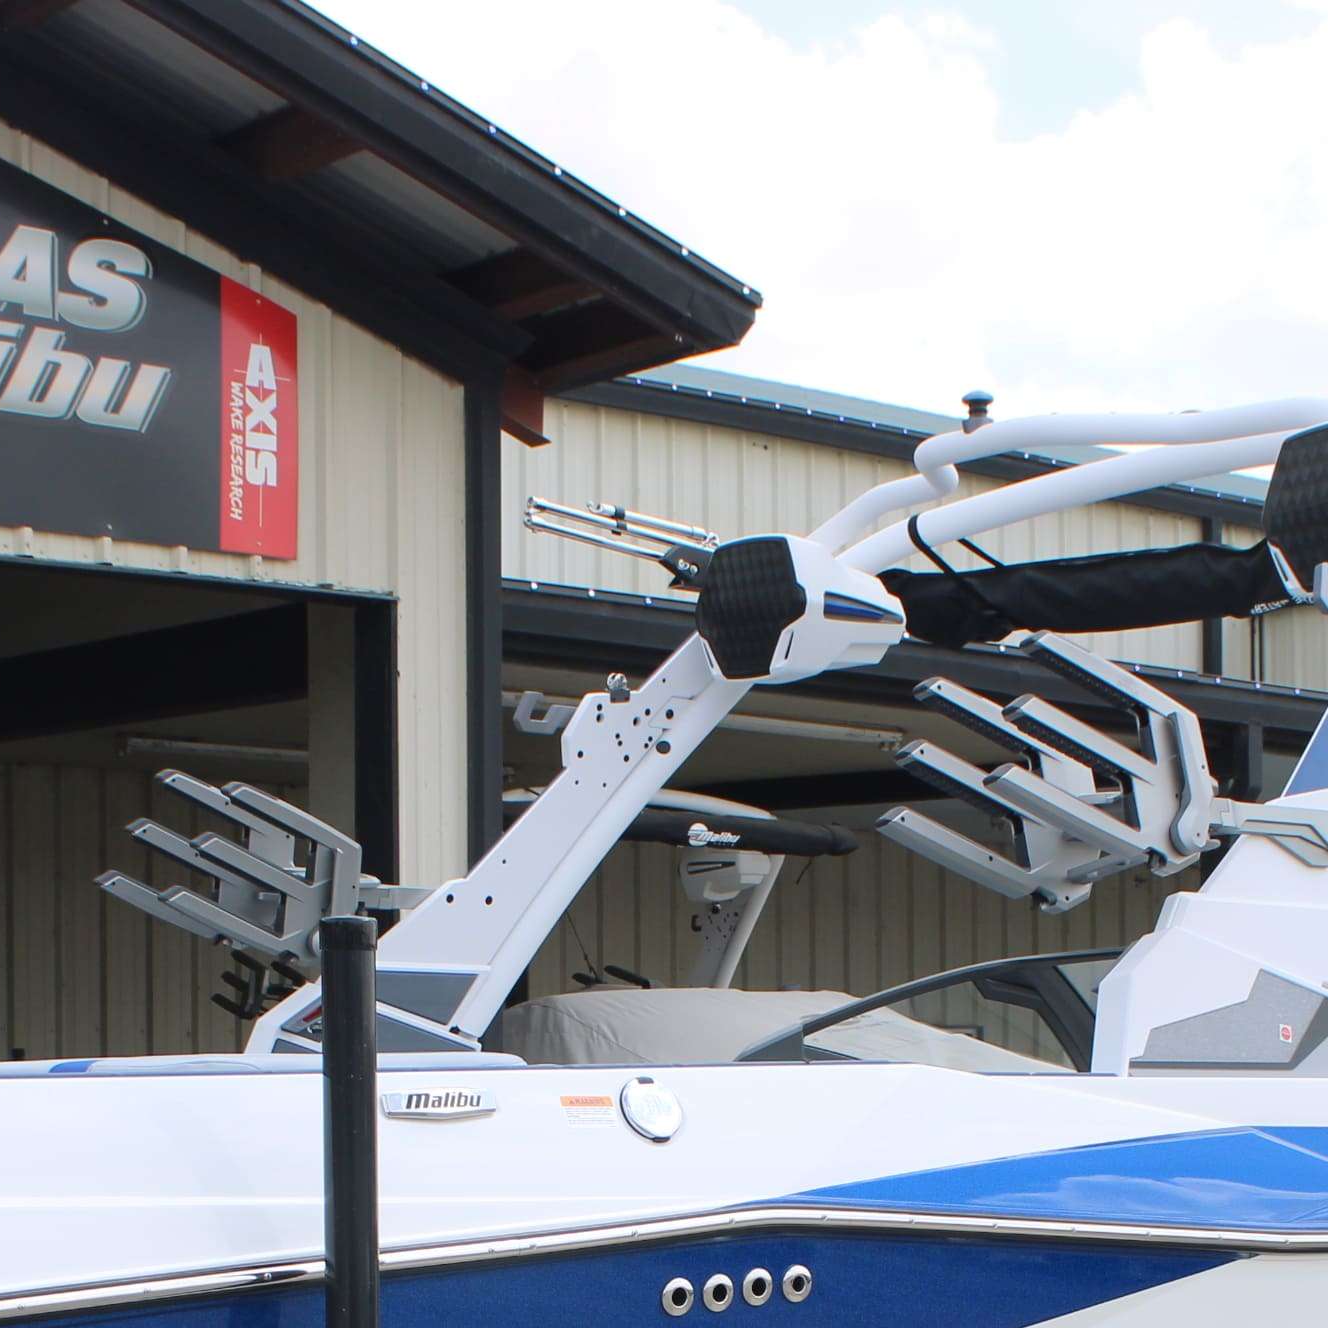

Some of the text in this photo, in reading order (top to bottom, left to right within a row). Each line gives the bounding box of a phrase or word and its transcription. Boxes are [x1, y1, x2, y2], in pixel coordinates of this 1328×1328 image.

[230, 381, 244, 521] WAKE RESEARCH
[245, 343, 277, 487] AXIS
[405, 1091, 482, 1110] Malibu
